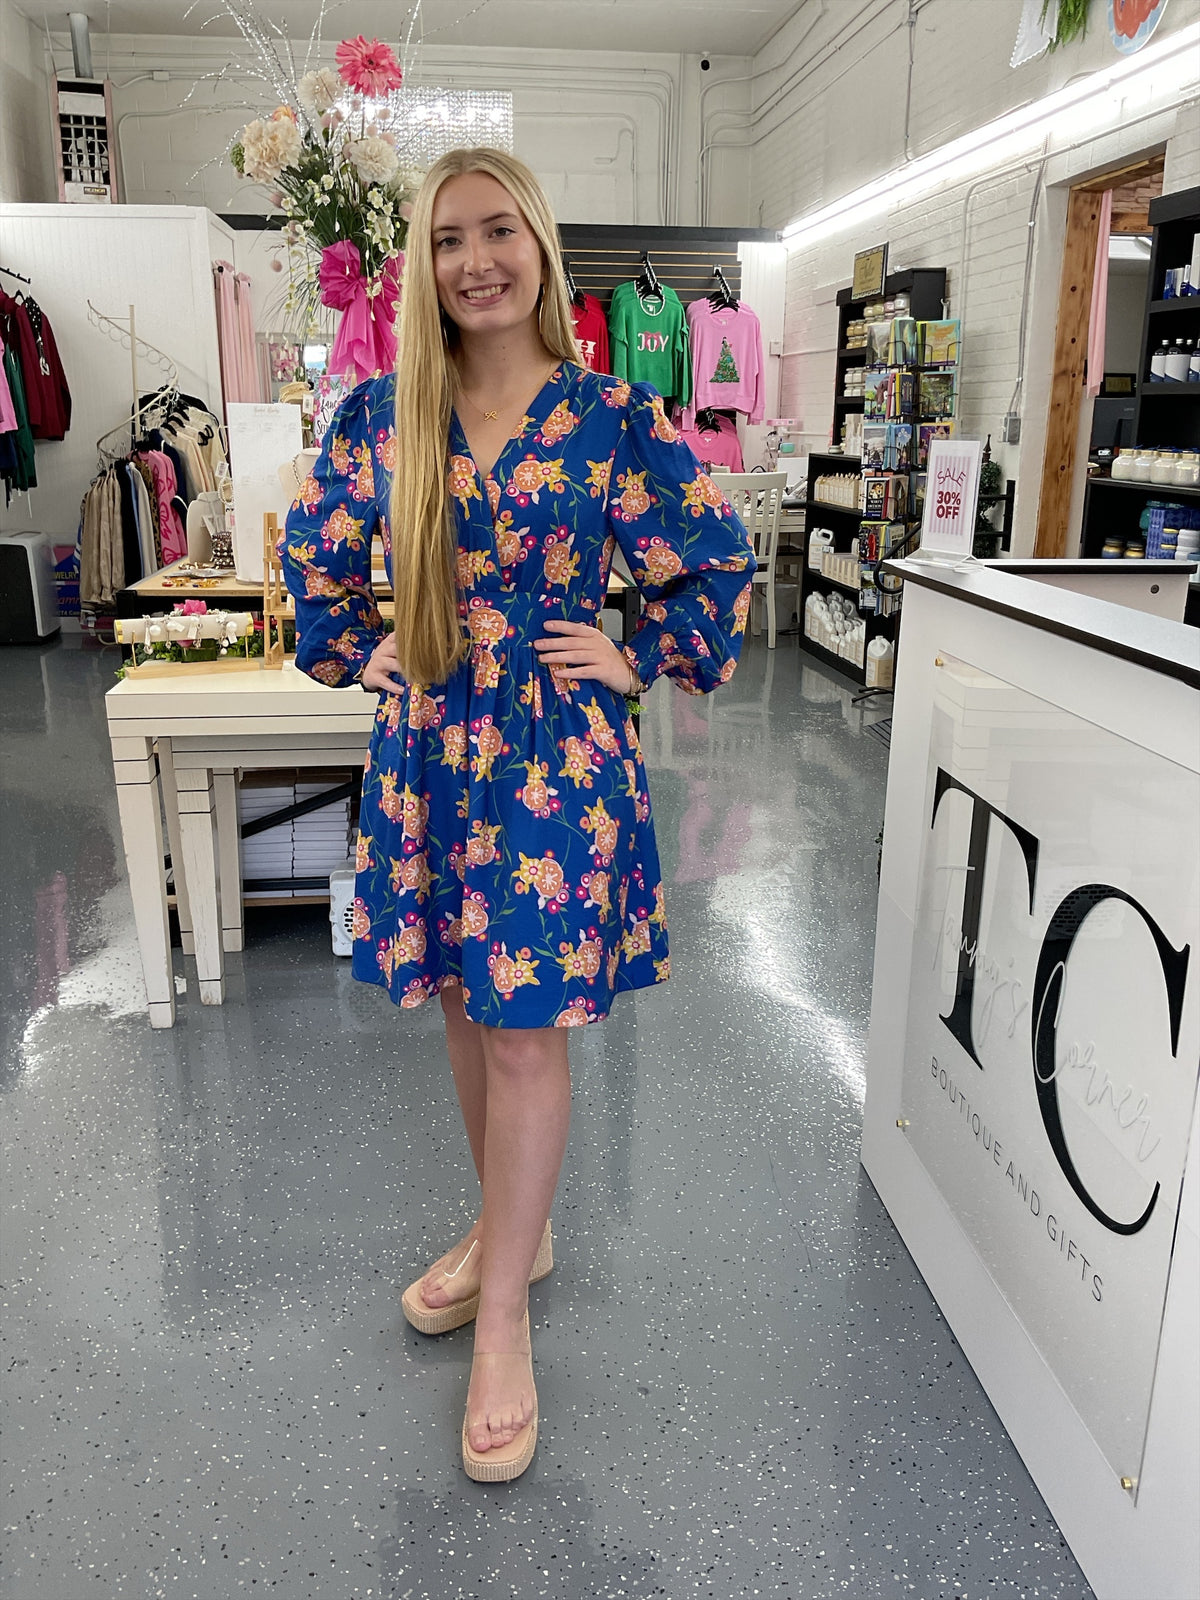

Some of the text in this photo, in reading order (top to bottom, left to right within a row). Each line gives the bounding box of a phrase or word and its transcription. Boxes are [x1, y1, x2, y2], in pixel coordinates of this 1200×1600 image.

[637, 332, 669, 353] JOY
[936, 467, 966, 487] SALE
[936, 491, 961, 506] 30%
[935, 505, 960, 519] OFF
[930, 1055, 1104, 1303] BOUTIQUE AND GIFTS
